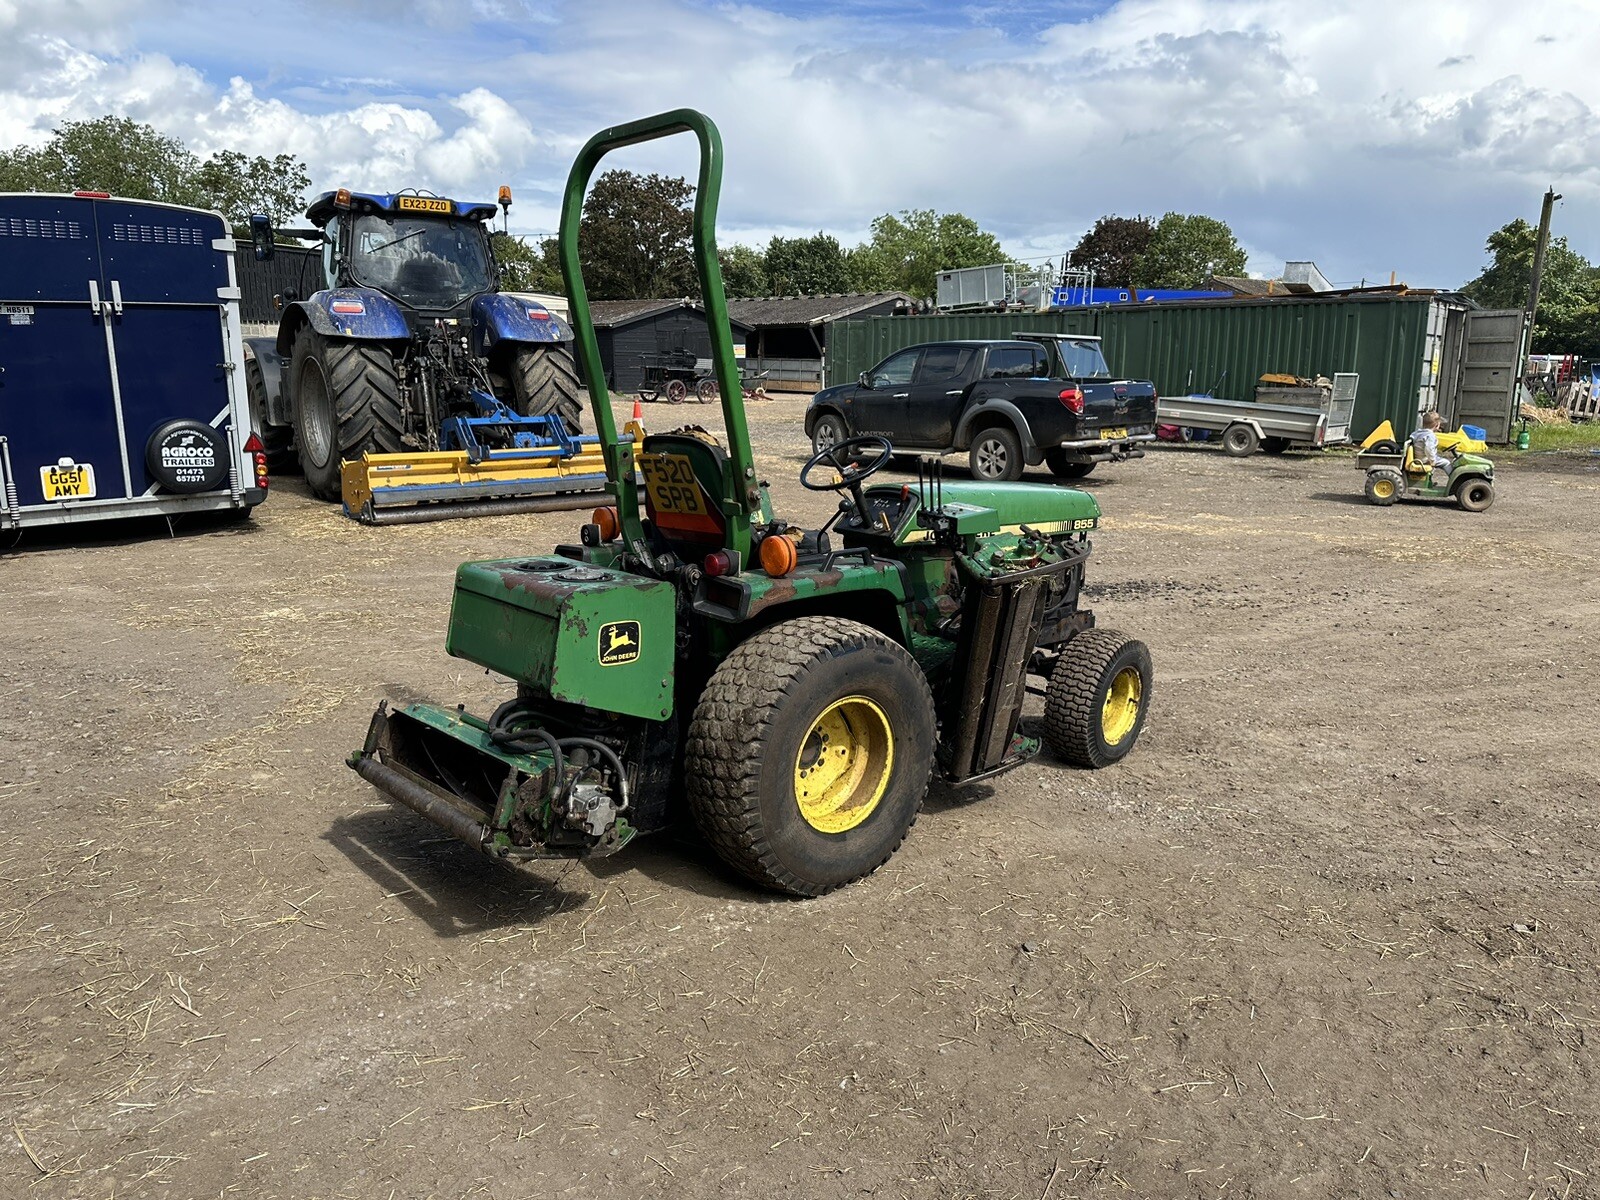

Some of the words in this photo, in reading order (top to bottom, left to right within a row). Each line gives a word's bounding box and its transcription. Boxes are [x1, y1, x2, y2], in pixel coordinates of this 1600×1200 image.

[403, 199, 427, 209] EX23
[6, 306, 30, 314] HB511
[161, 447, 214, 457] AGROCO
[639, 458, 696, 485] F520
[50, 471, 82, 485] GG51
[55, 484, 80, 497] AMY
[656, 485, 698, 512] SPB
[1073, 518, 1094, 530] 855
[601, 655, 618, 663] JOHN
[618, 652, 637, 660] DEERE
